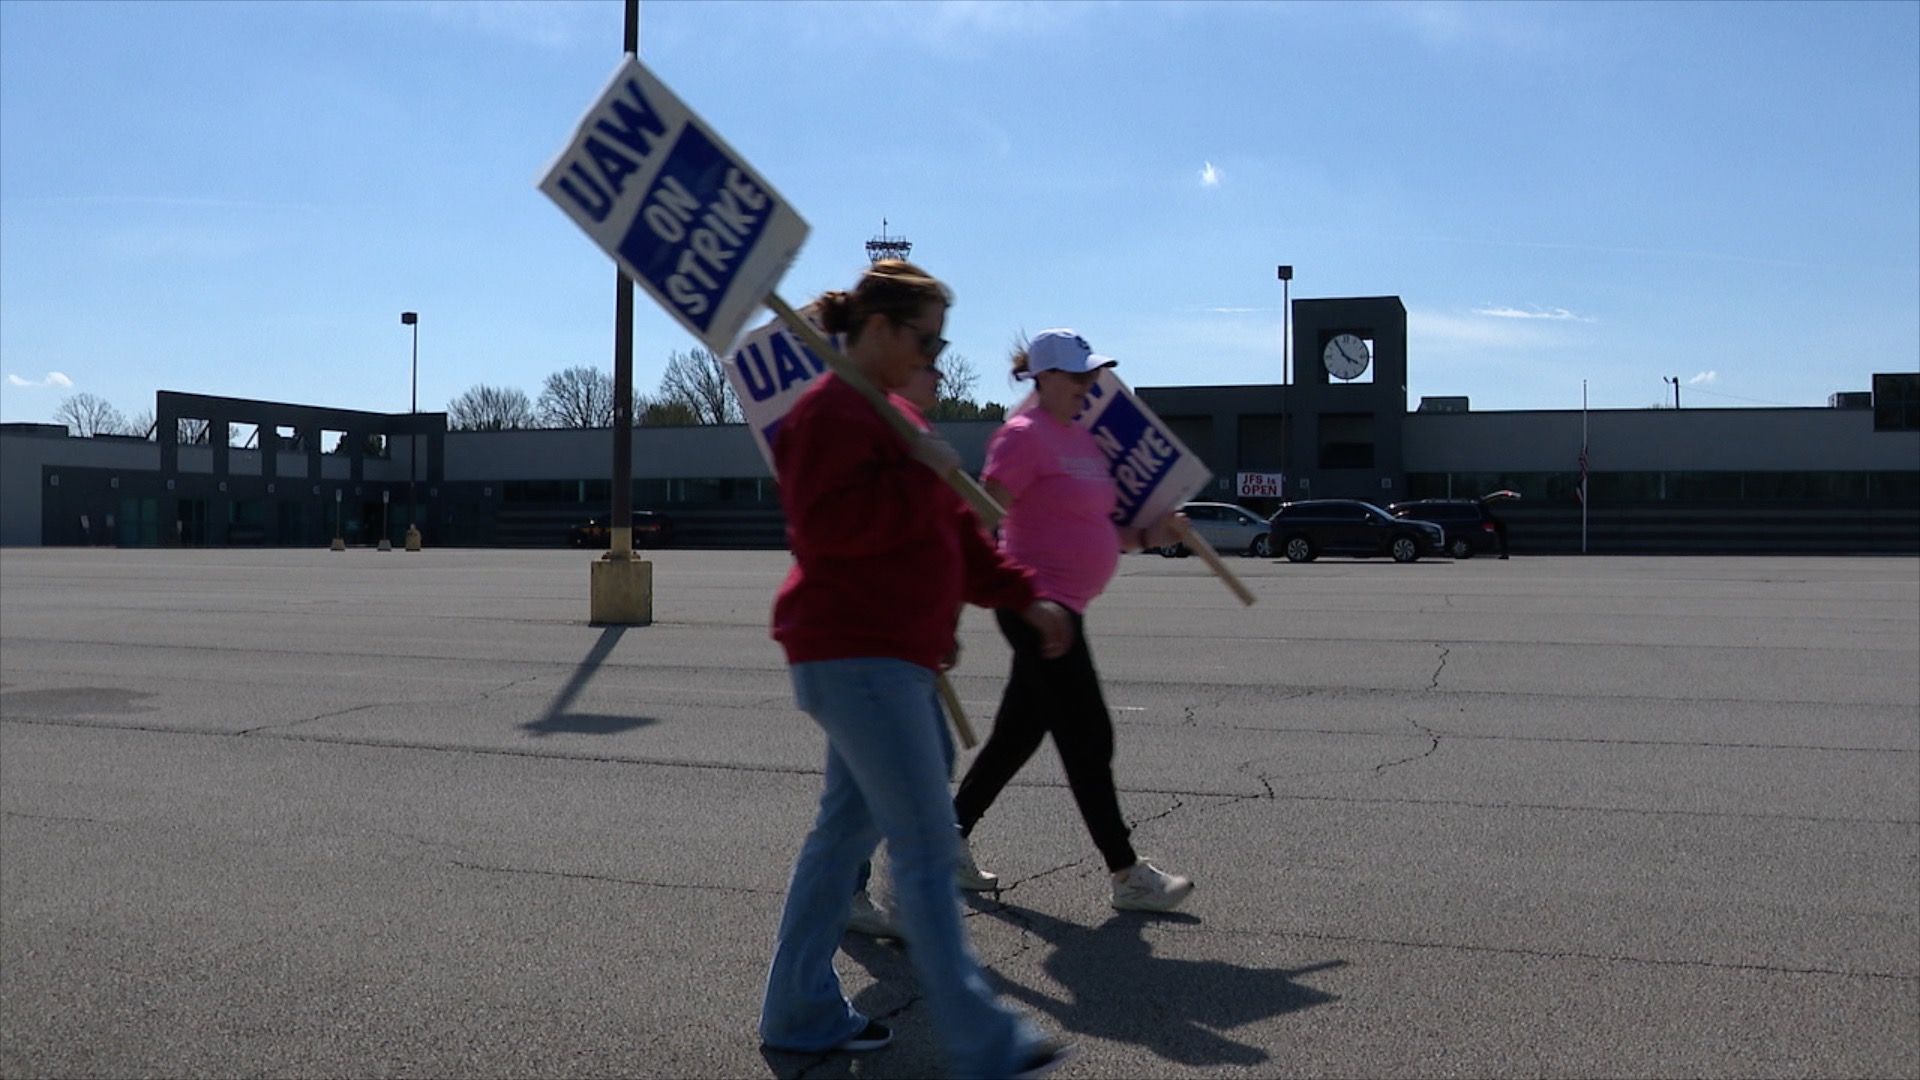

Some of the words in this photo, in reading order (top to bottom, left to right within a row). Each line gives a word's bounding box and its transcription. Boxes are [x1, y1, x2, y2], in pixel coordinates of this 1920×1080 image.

[558, 77, 668, 223] UAW
[643, 174, 701, 243] ON
[665, 166, 768, 315] STRIKE
[1094, 426, 1124, 459] N
[1242, 485, 1277, 496] OPEN
